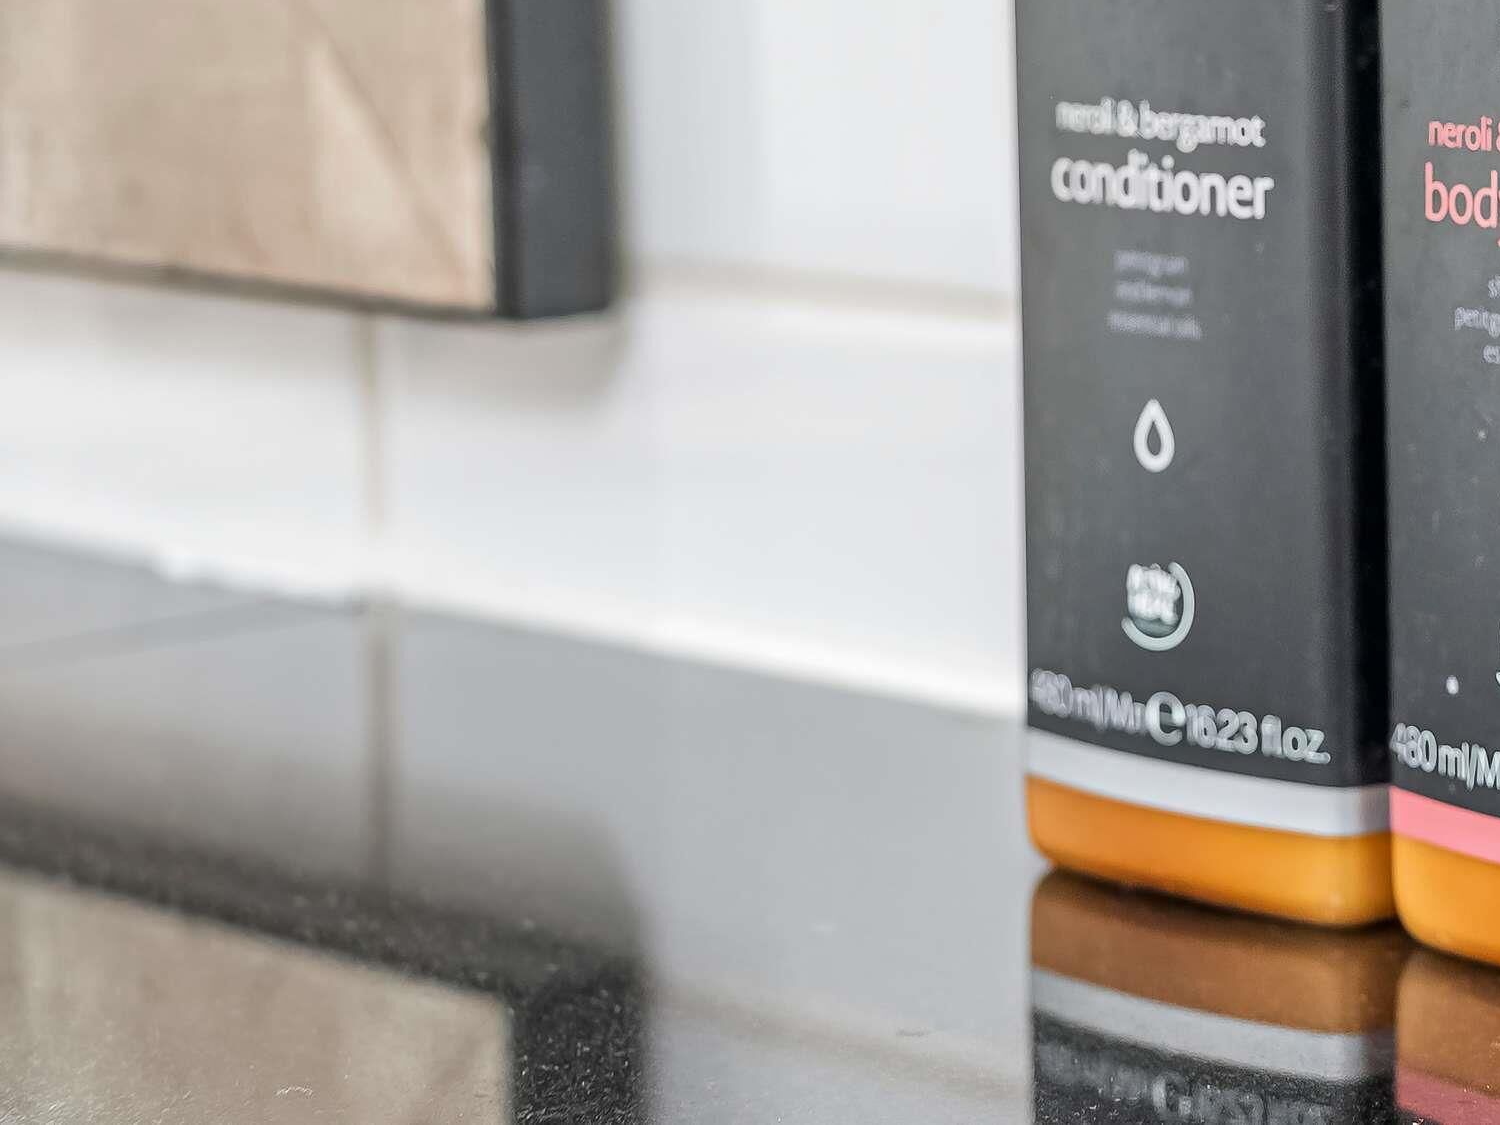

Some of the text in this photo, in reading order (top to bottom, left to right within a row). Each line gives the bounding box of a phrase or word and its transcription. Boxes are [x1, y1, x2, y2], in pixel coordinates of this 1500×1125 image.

[1429, 116, 1493, 152] neroli
[1051, 149, 1275, 220] conditioner
[1390, 722, 1438, 773] 480
